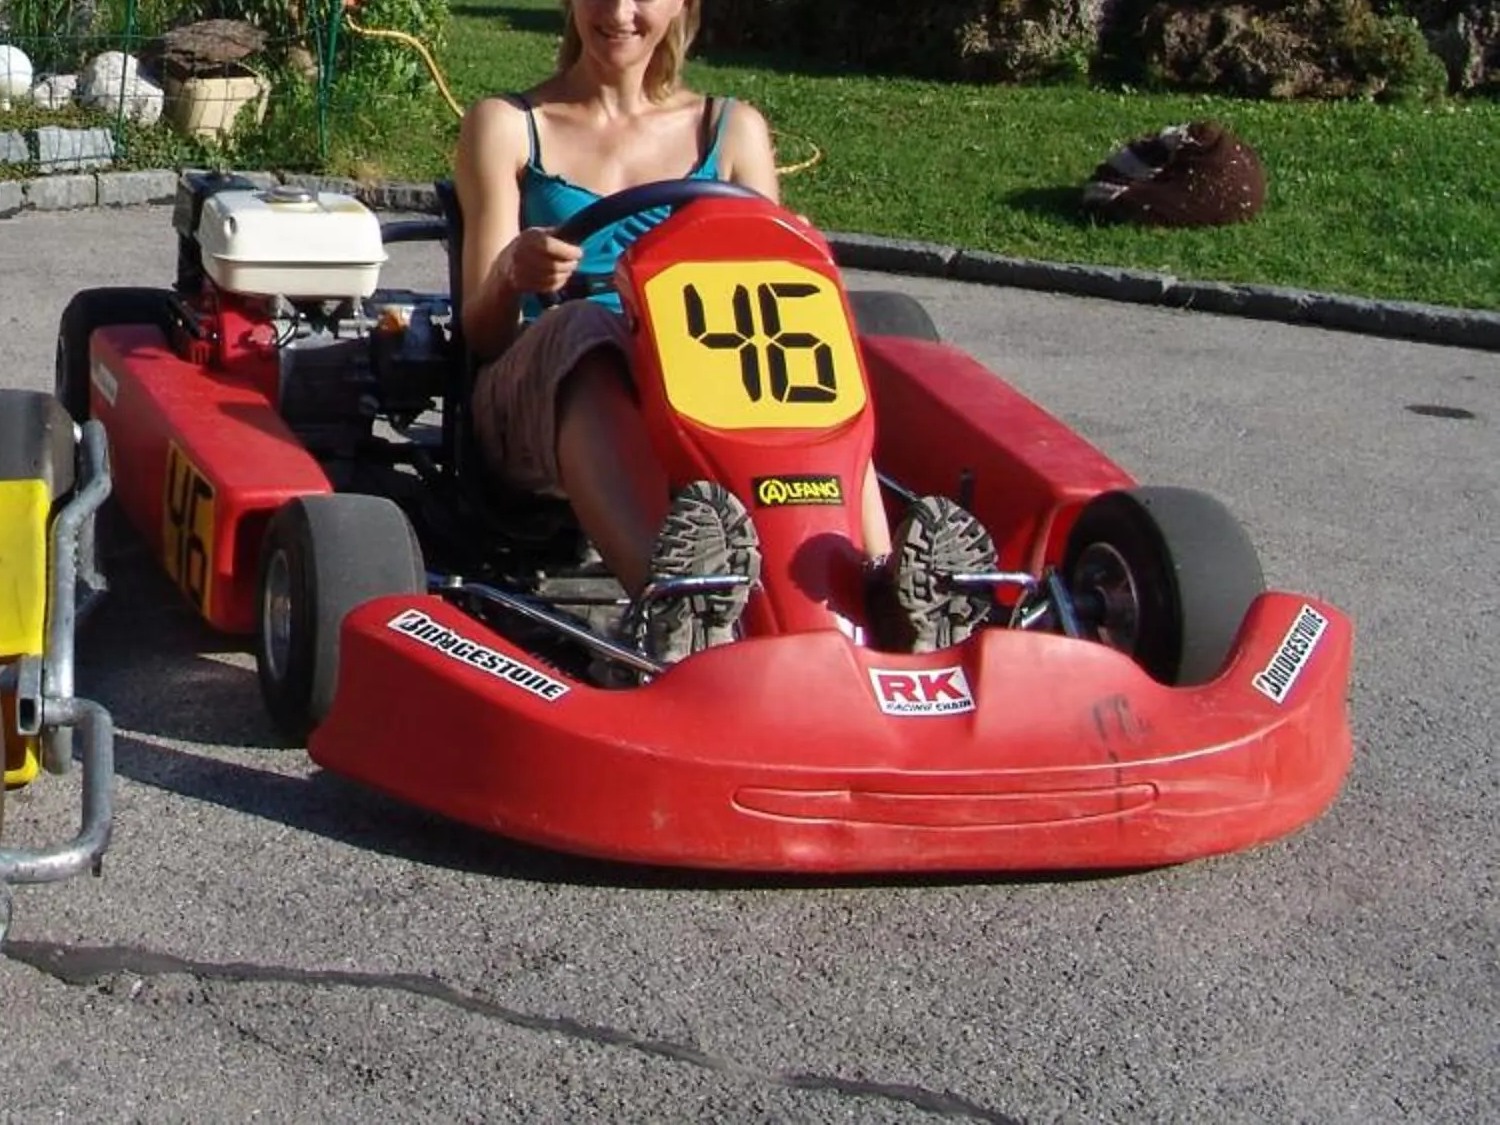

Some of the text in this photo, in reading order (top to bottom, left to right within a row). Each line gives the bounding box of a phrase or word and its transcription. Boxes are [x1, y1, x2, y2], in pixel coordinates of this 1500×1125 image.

[683, 282, 837, 403] 46
[167, 447, 213, 613] 46
[759, 478, 839, 504] ALFANO
[397, 610, 566, 699] BRIDGESTONE
[877, 671, 965, 702] RK
[1254, 607, 1324, 698] BRIDGESTONE
